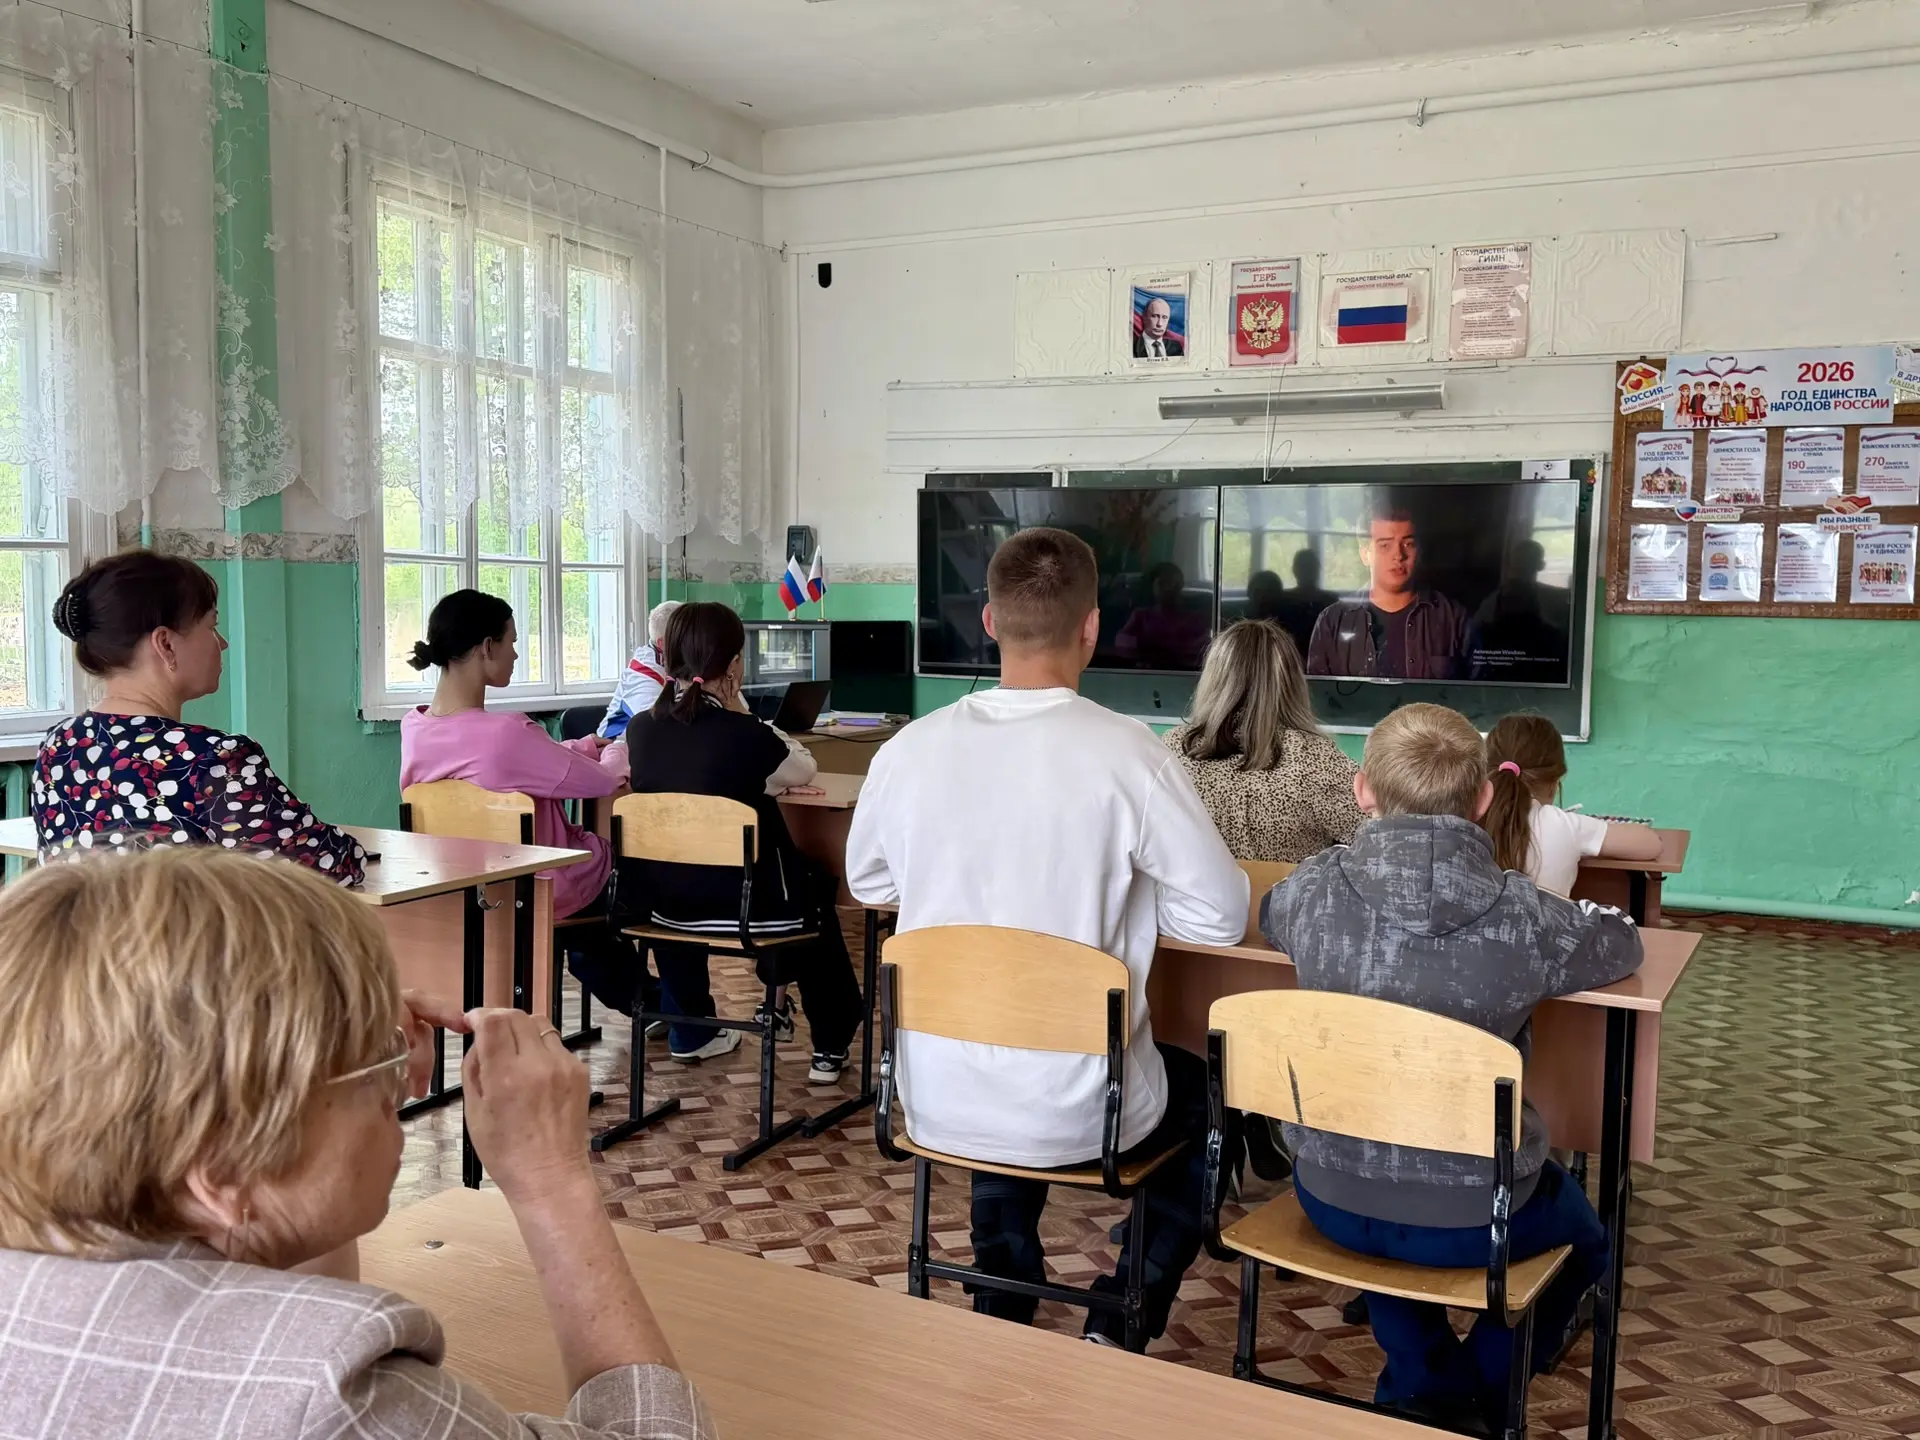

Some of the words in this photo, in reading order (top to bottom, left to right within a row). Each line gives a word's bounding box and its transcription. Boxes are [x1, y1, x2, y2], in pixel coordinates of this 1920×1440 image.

[1478, 254, 1506, 263] ГИМН
[1252, 272, 1277, 282] ГЕРБ
[1336, 273, 1395, 283] ГОСУДАРСТВЕННЫЙ
[1797, 361, 1855, 383] 2026
[1897, 370, 1904, 378] В
[1623, 386, 1664, 405] РОССИЯ
[1781, 390, 1808, 401] ГОД
[1812, 388, 1877, 400] ЕДИНСТВА
[1770, 400, 1832, 412] НАРОДОВ
[1834, 398, 1890, 410] РОССИИ
[1662, 443, 1683, 451] 2026
[1787, 460, 1806, 470] 190
[1864, 456, 1885, 467] 270
